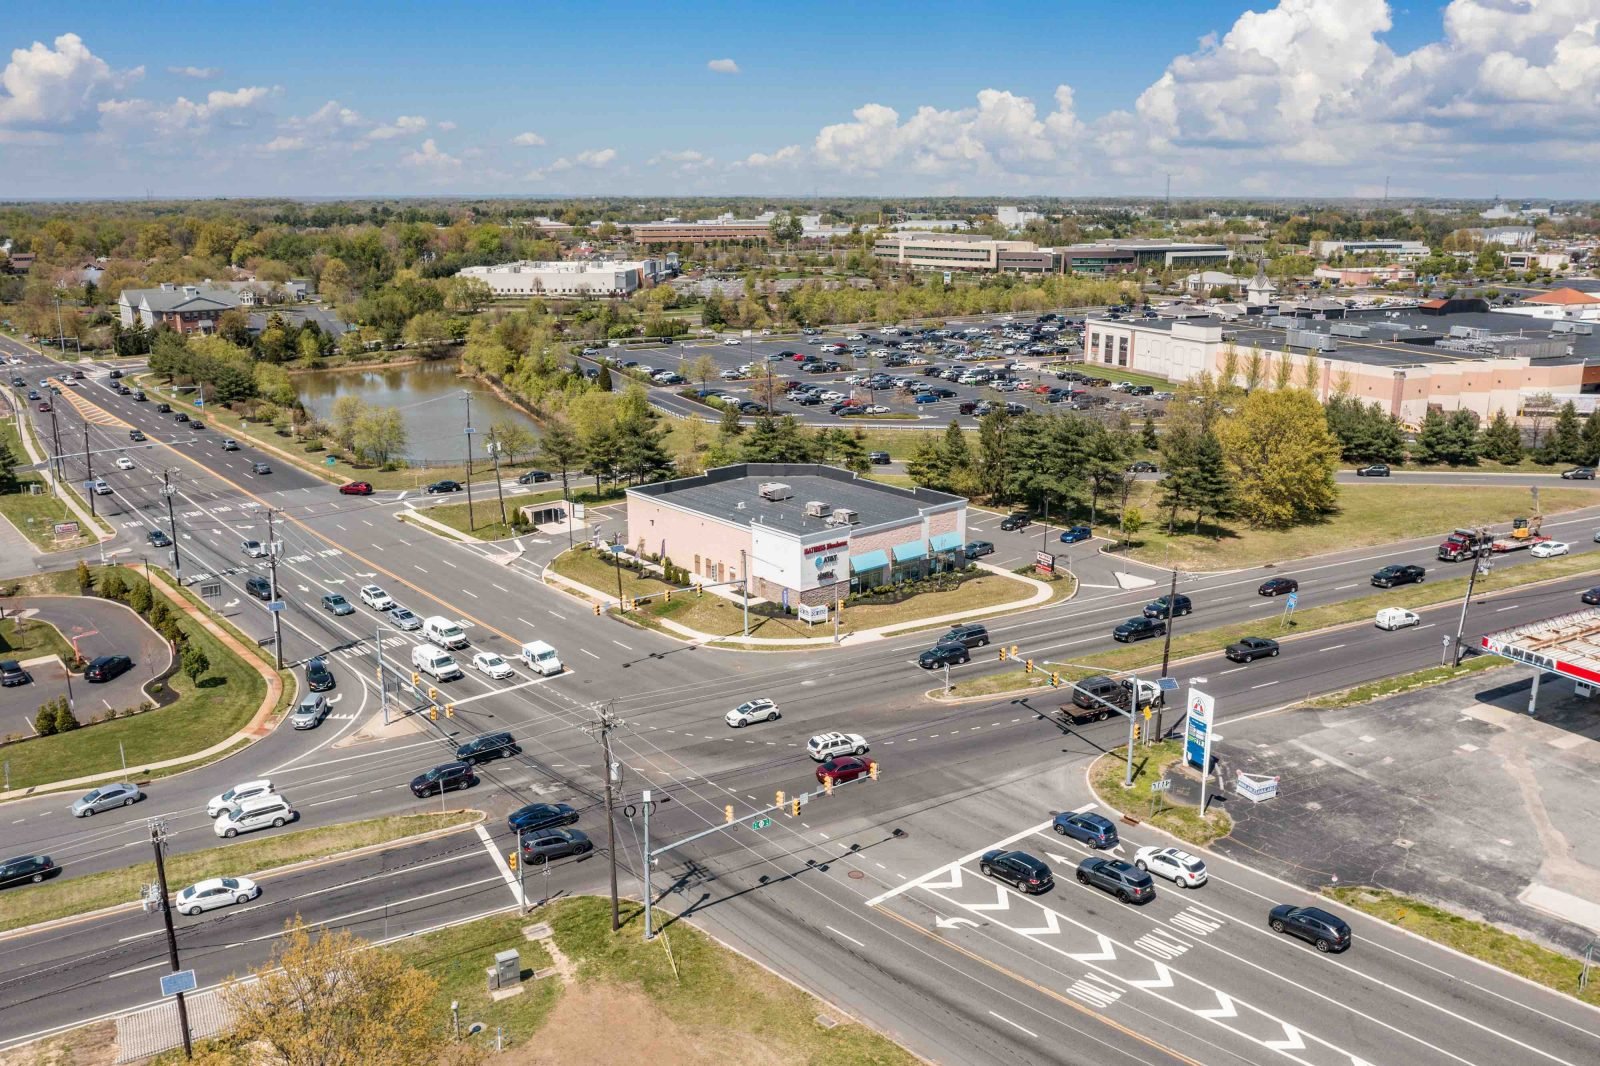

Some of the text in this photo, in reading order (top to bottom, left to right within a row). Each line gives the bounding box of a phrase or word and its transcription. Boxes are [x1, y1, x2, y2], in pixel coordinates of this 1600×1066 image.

[338, 645, 371, 659] ONLY
[1169, 906, 1225, 936] ONLY
[1134, 927, 1194, 960] ONLY
[1066, 972, 1127, 1008] ONLY
